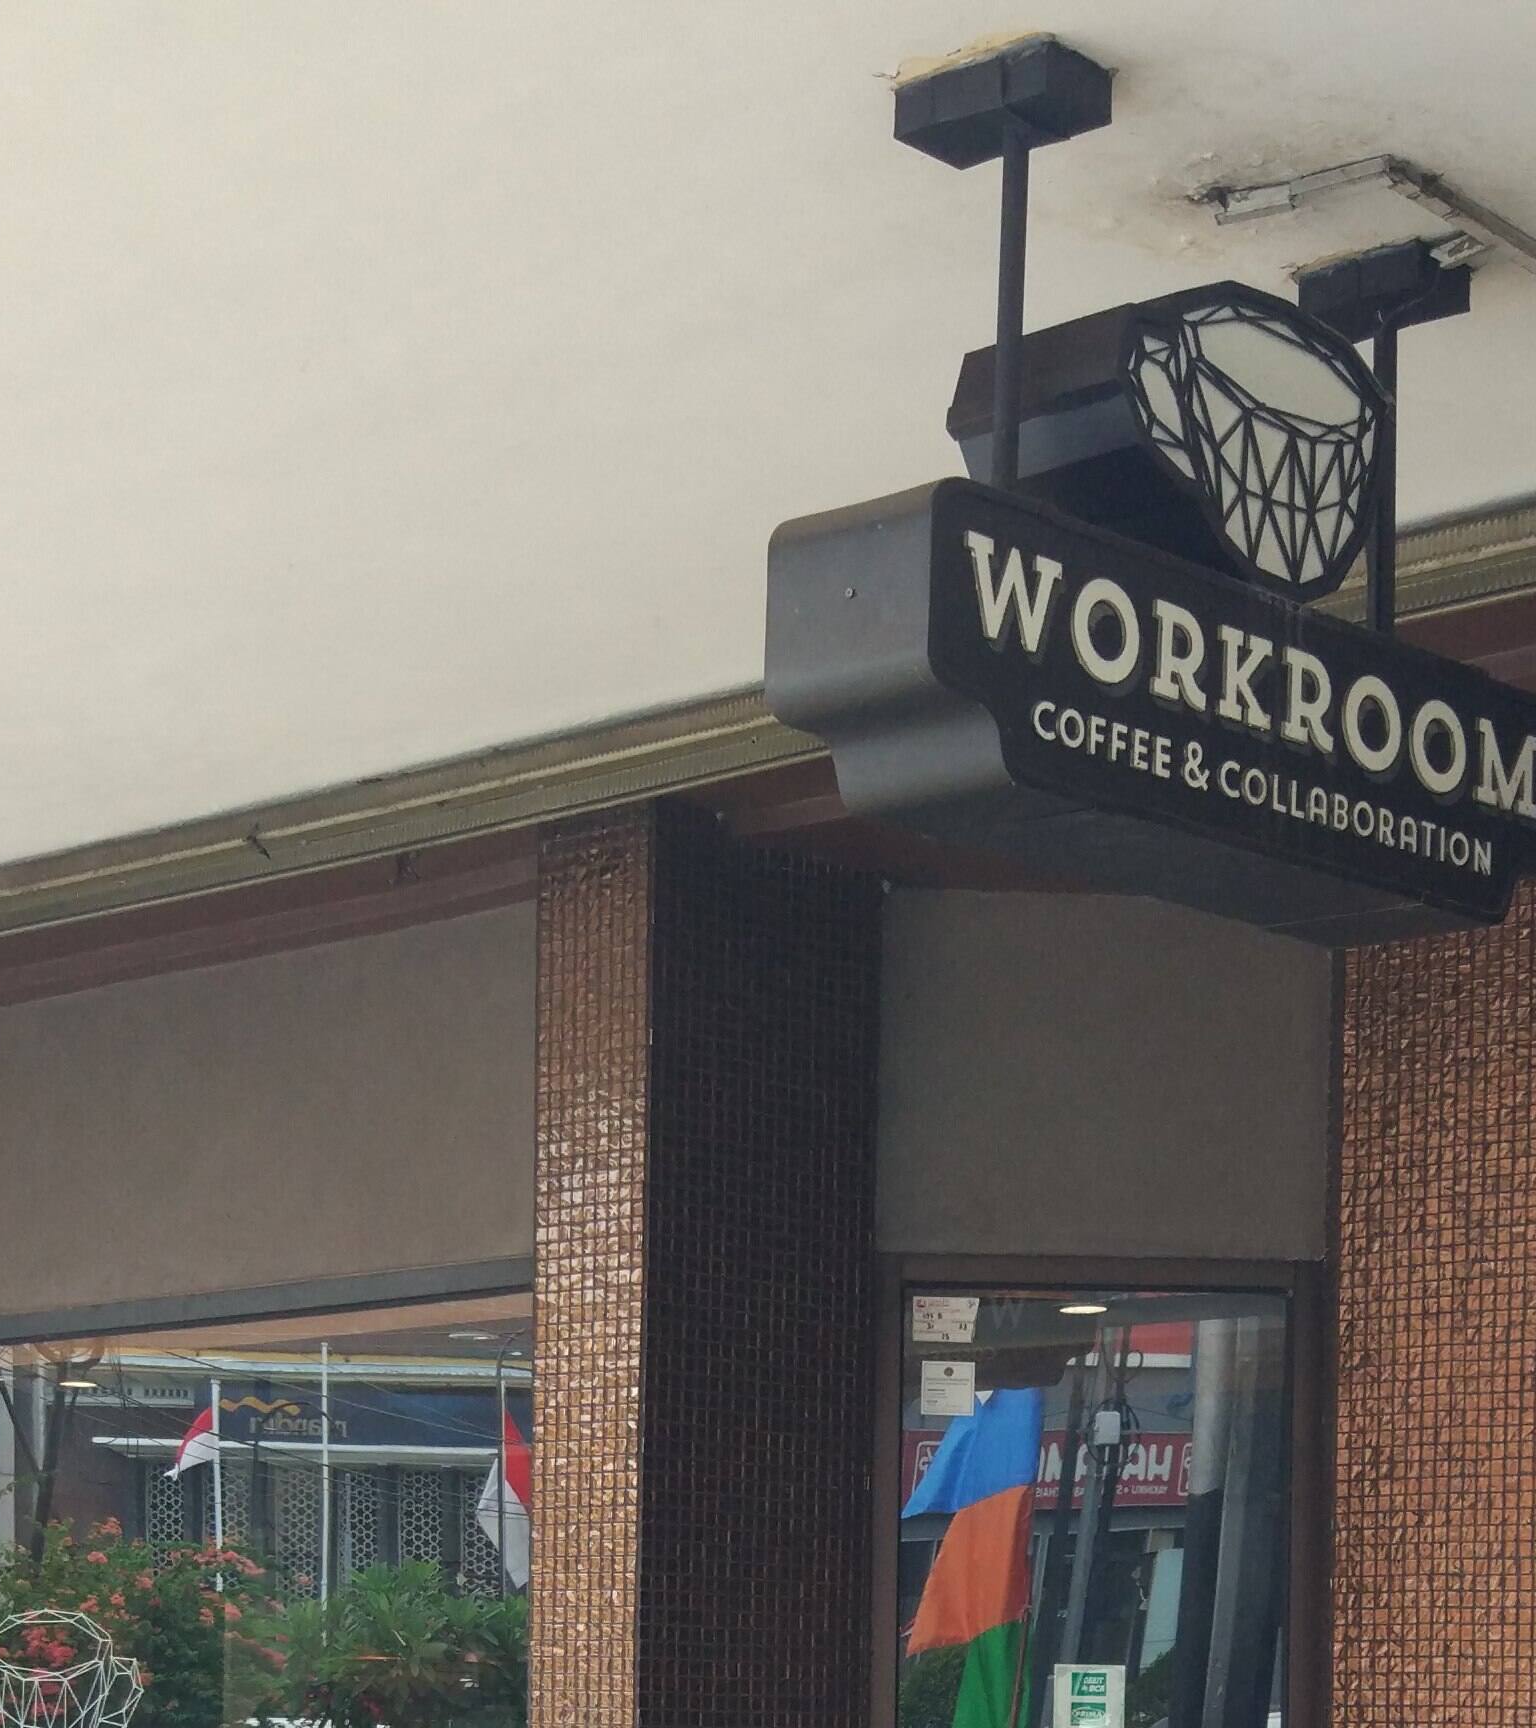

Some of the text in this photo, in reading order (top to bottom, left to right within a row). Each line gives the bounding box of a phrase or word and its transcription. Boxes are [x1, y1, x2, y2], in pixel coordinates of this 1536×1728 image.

[1032, 701, 1493, 876] COFFEE & COLLABORATION
